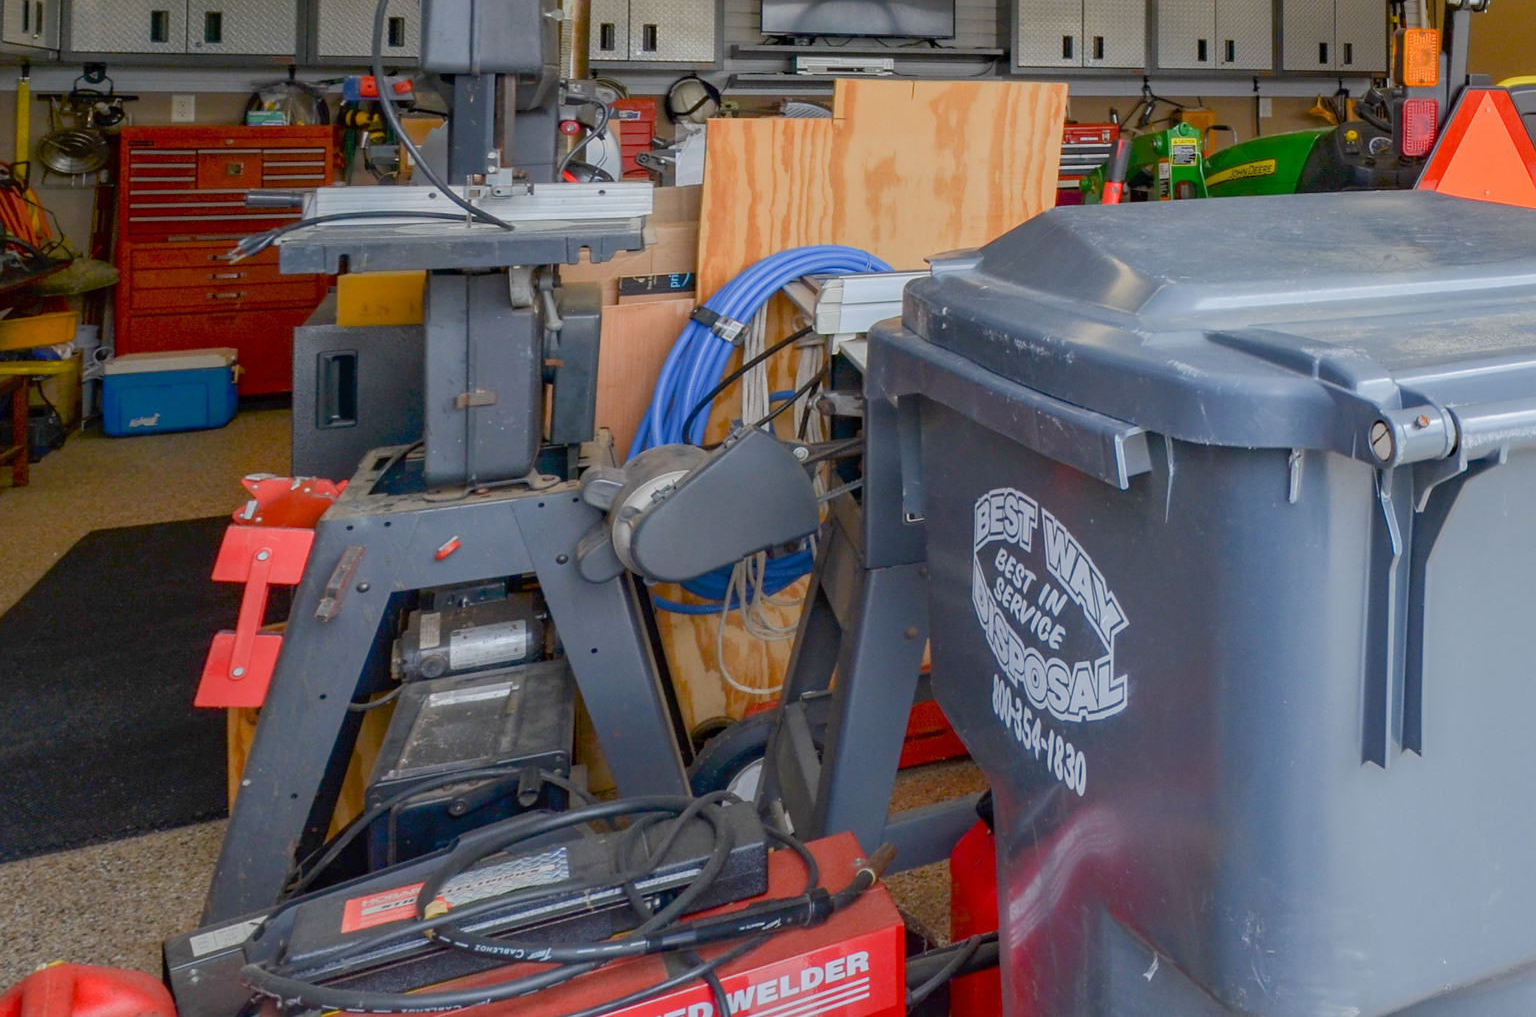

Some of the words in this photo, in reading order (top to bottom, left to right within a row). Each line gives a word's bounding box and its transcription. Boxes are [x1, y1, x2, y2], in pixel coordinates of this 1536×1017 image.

[1229, 168, 1247, 179] JOHN
[1248, 165, 1273, 175] DEERE
[974, 488, 1038, 552] BEST
[1042, 508, 1129, 643] WAY
[994, 548, 1037, 592] BEST
[1038, 582, 1068, 617] IN
[973, 562, 1128, 722] DISPOSAL
[993, 579, 1066, 650] SERVICE
[992, 674, 1087, 797] 800-354-1830
[726, 950, 870, 1015] WELDER
